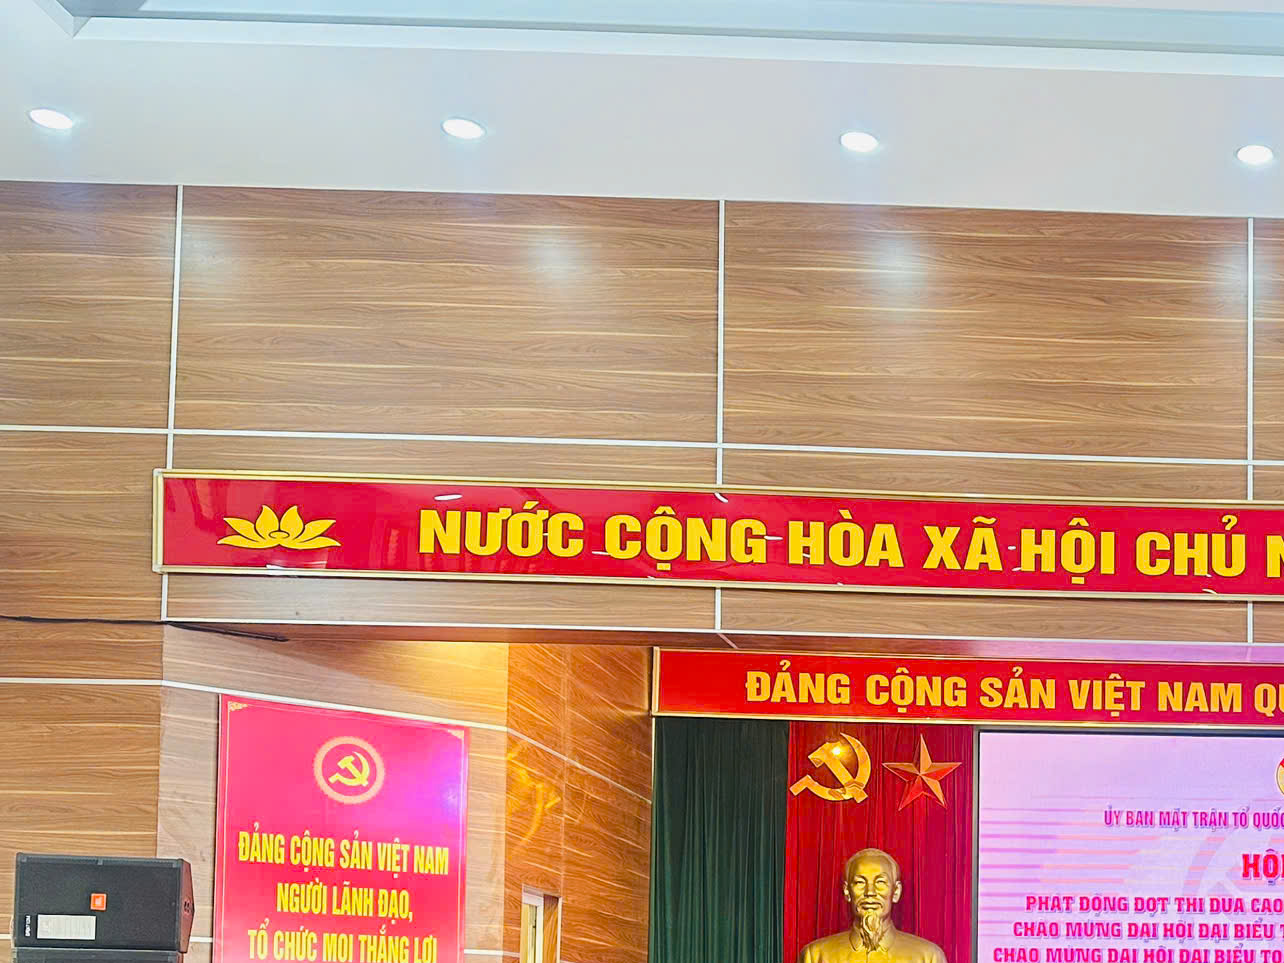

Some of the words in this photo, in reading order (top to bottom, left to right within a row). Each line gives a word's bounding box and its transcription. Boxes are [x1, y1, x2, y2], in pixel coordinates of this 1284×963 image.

[418, 502, 585, 557] NƯỚC
[604, 506, 766, 573] CỘNG
[788, 507, 903, 569] HÒA
[922, 516, 1002, 571] XÃ
[1020, 518, 1114, 584] HỘI
[1135, 514, 1243, 578] CHỦ
[745, 660, 850, 705] ĐẢNG
[866, 667, 967, 713] CỘNG
[979, 666, 1055, 709] SẢN
[1068, 673, 1146, 717] VIỆT
[1158, 681, 1242, 713] NAM
[1104, 805, 1121, 826] ỦY
[1126, 811, 1153, 827] BAN
[1159, 808, 1188, 831] MẶT
[1192, 808, 1228, 832] TRẬN
[1232, 806, 1250, 828] TỔ
[238, 823, 285, 865] ĐẢNG
[290, 831, 335, 873] CỘNG
[340, 830, 372, 870] SẢN
[377, 838, 409, 879] VIỆT
[414, 845, 449, 876] NAM
[276, 877, 327, 916] NGƯỜI
[333, 881, 373, 918] LÃNH
[378, 889, 413, 924] ĐẠO,
[247, 919, 270, 960] TỔ
[273, 925, 317, 962] CHỨC
